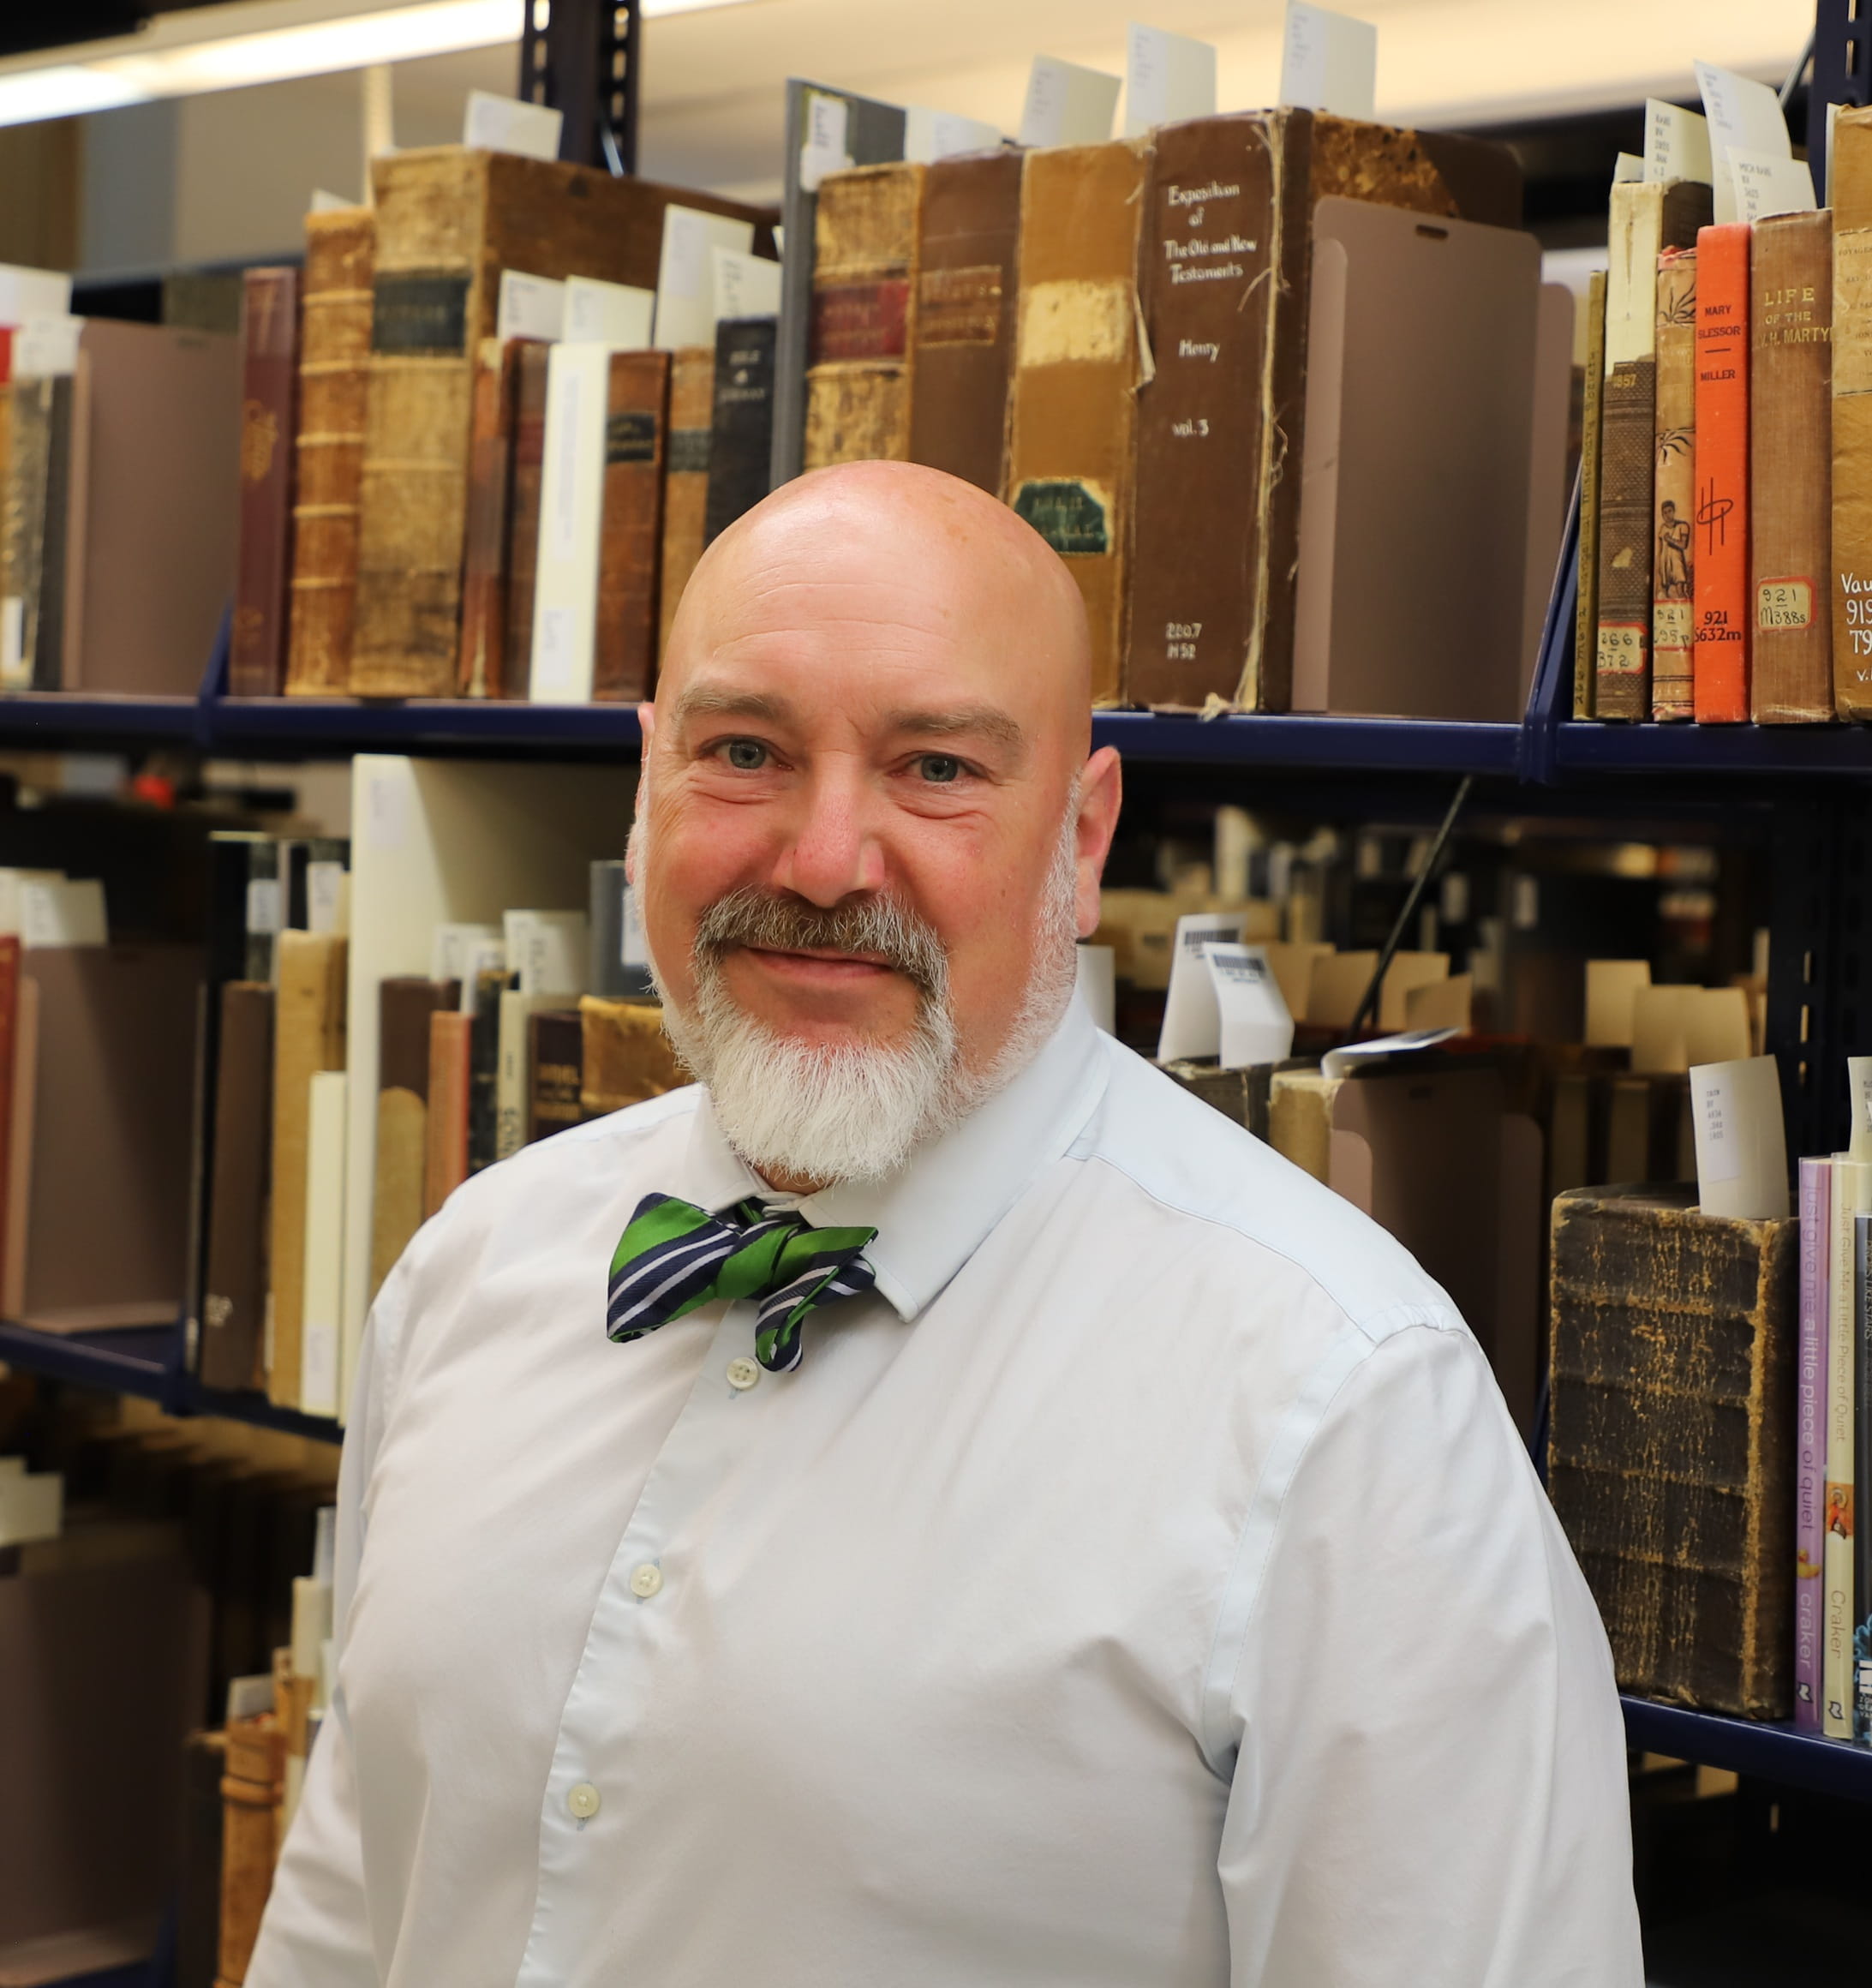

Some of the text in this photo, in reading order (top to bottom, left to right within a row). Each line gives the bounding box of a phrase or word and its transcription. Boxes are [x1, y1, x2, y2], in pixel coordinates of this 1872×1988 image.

[1168, 181, 1241, 207] Exposition
[1188, 206, 1205, 226] of
[1163, 234, 1258, 260] The Old and New
[1170, 262, 1243, 284] Testaments
[1765, 287, 1815, 307] LIFE
[1705, 305, 1731, 317] MARY
[1765, 311, 1811, 325] OF THE
[1698, 326, 1742, 339] SLESSOR
[1784, 327, 1833, 344] MARTY
[1179, 339, 1220, 363] Henry
[1700, 369, 1736, 382] MILLER
[1762, 588, 1797, 602] 921
[1704, 610, 1728, 625] 921
[1840, 1202, 1851, 1231] Just
[1840, 1237, 1851, 1266] Give
[1839, 1272, 1851, 1291] Me
[1838, 1306, 1850, 1340] Little
[1800, 1185, 1823, 1530] just give me a little piece of quiet
[1836, 1345, 1849, 1383] Piece
[1836, 1386, 1848, 1402] of
[1834, 1404, 1848, 1442] Quiet
[1799, 1592, 1815, 1668] craker
[1830, 1590, 1845, 1660] Craker
